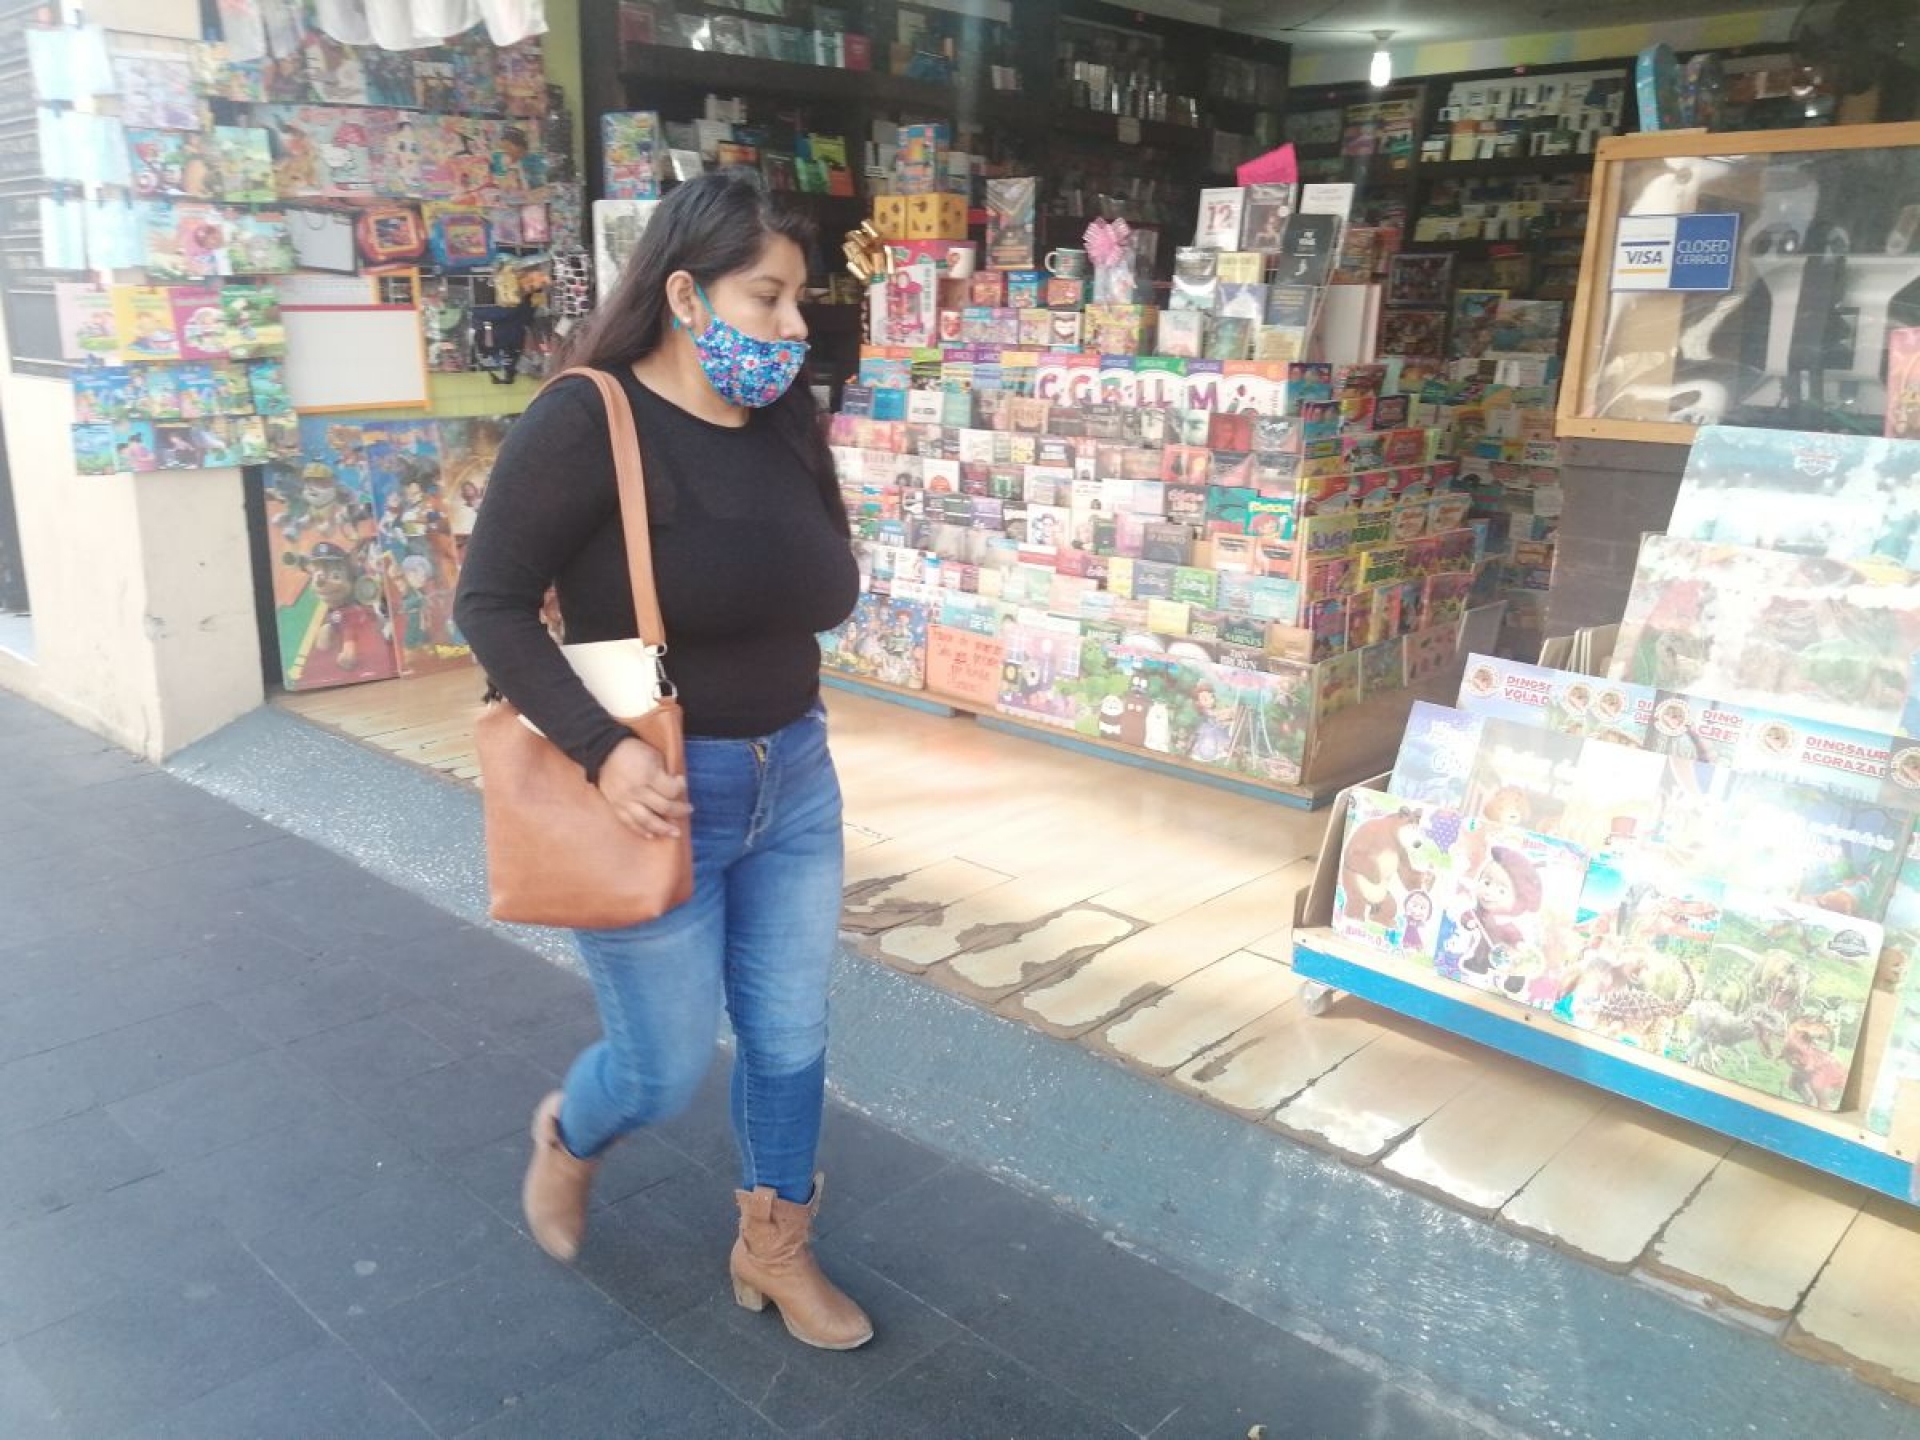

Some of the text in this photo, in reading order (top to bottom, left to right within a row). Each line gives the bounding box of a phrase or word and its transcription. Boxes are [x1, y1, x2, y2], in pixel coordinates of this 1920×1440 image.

[1677, 239, 1731, 254] CLOSED
[1625, 250, 1665, 265] VISA
[1676, 253, 1729, 265] CERRADO
